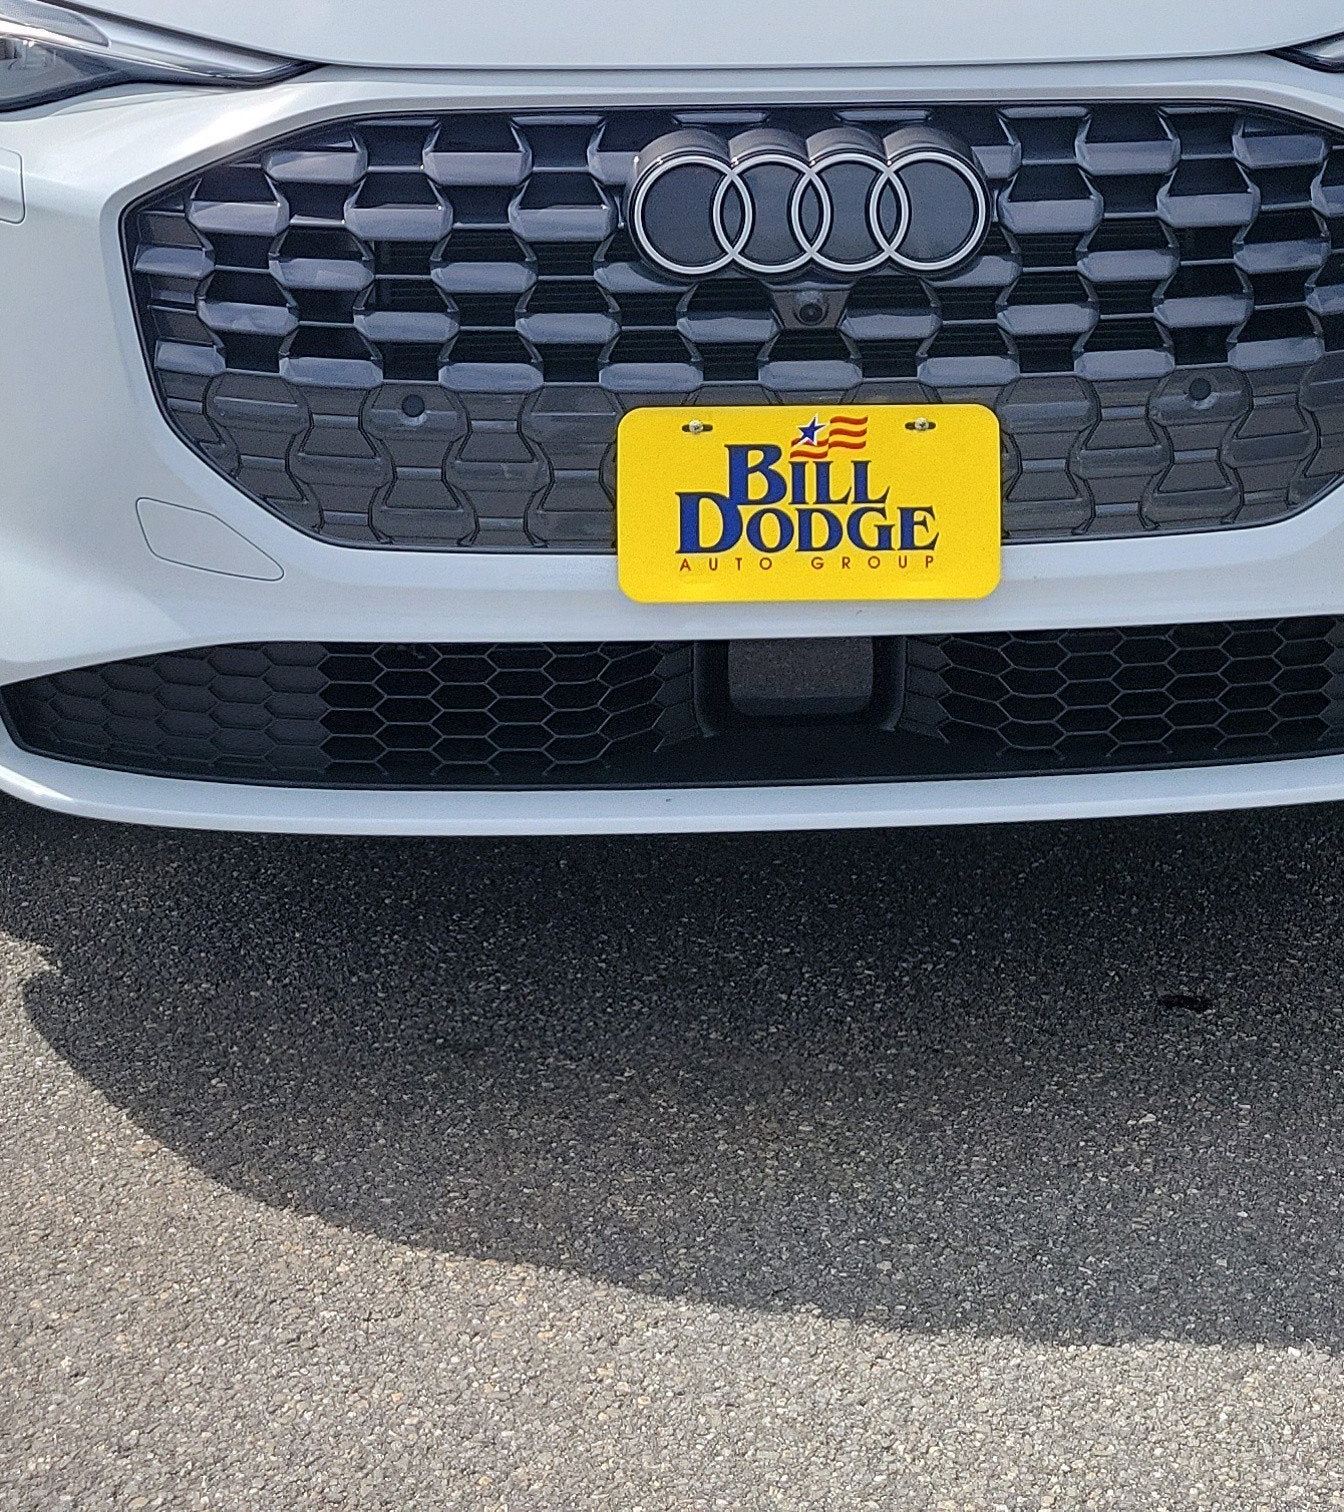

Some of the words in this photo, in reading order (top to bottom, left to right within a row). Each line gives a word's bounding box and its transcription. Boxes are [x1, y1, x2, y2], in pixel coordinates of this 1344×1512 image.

[723, 443, 891, 506] BILL
[674, 491, 940, 554] DODGE
[678, 556, 773, 572] AUTO
[810, 554, 935, 571] GROUP
